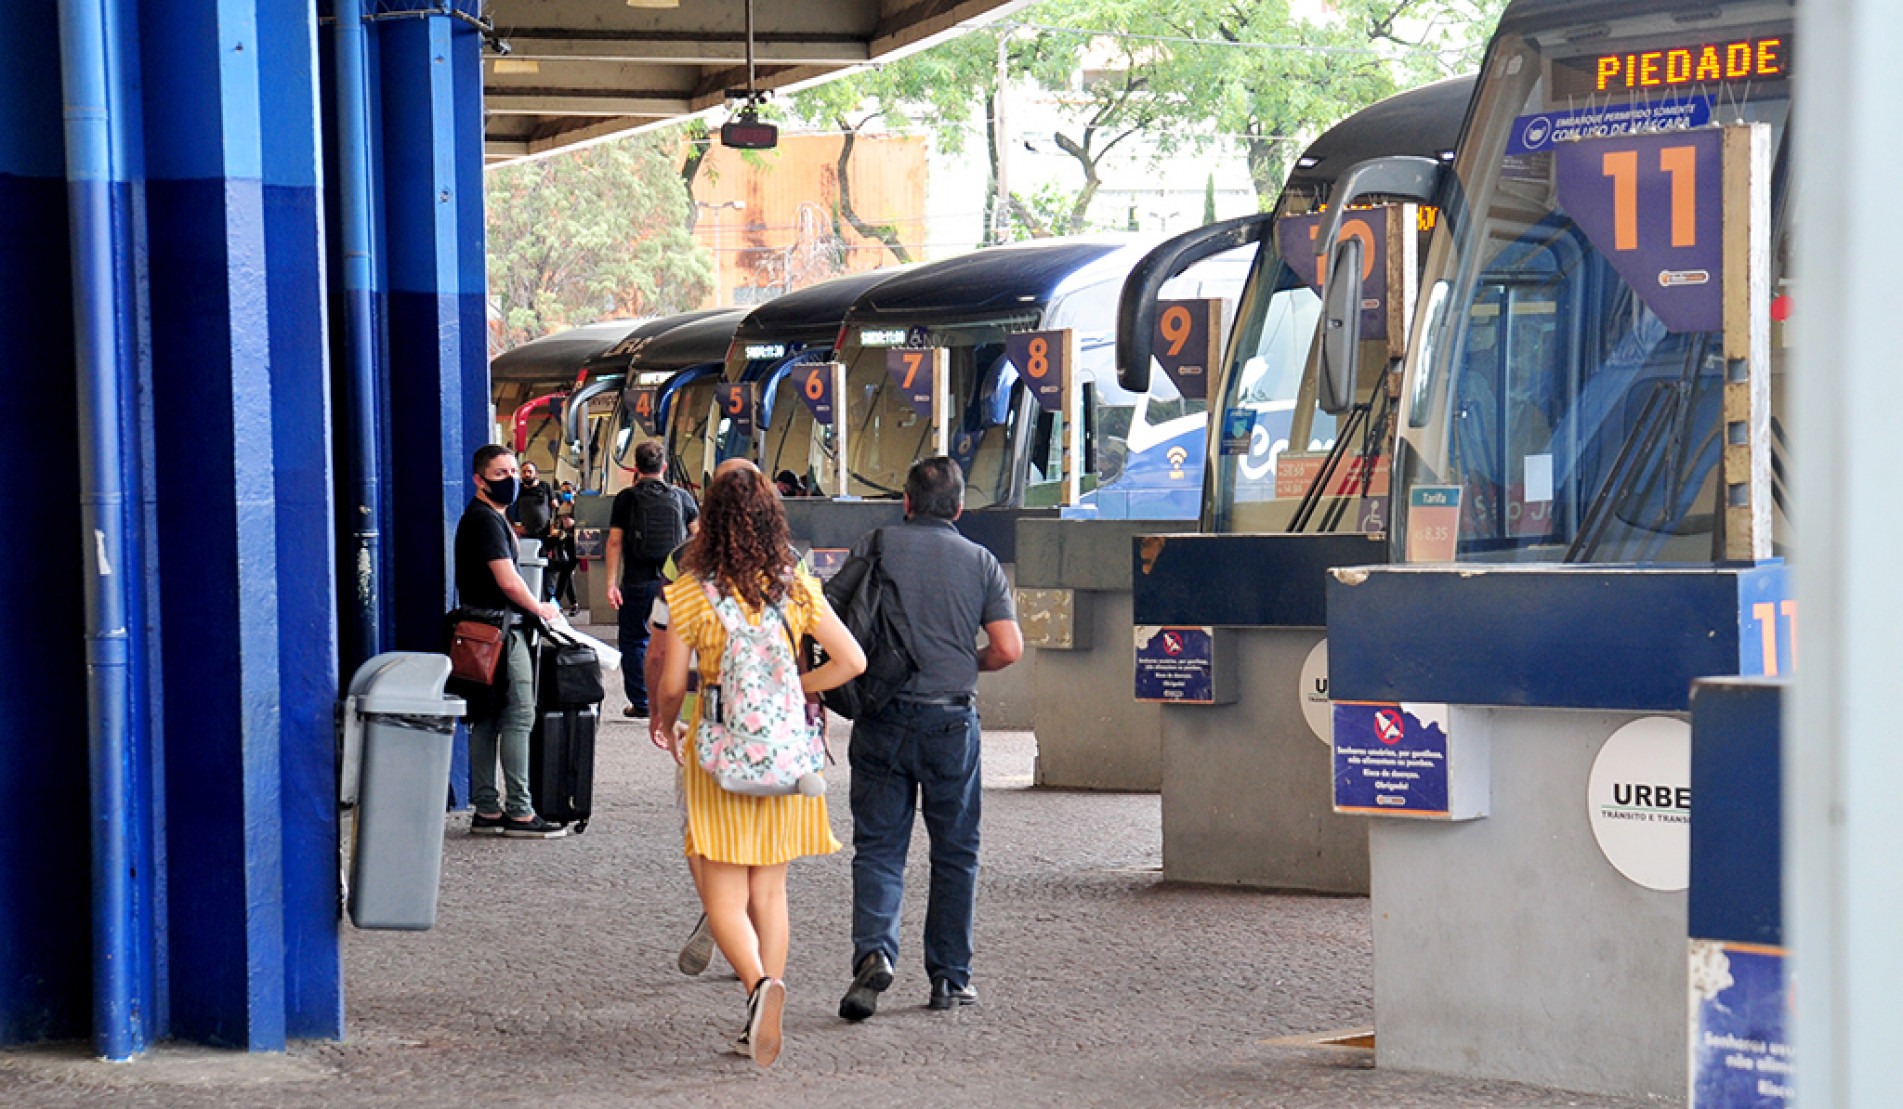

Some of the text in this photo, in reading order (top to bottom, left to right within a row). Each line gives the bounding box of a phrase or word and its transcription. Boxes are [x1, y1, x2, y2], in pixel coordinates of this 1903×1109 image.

[1596, 38, 1781, 91] PIEDADE
[1603, 145, 1696, 251] 11
[1160, 305, 1193, 356] 9
[902, 353, 924, 389] 7
[1027, 337, 1049, 378] 8
[728, 387, 744, 414] 5
[805, 369, 824, 400] 6
[635, 392, 651, 417] 4
[1423, 491, 1446, 503] Tarifa
